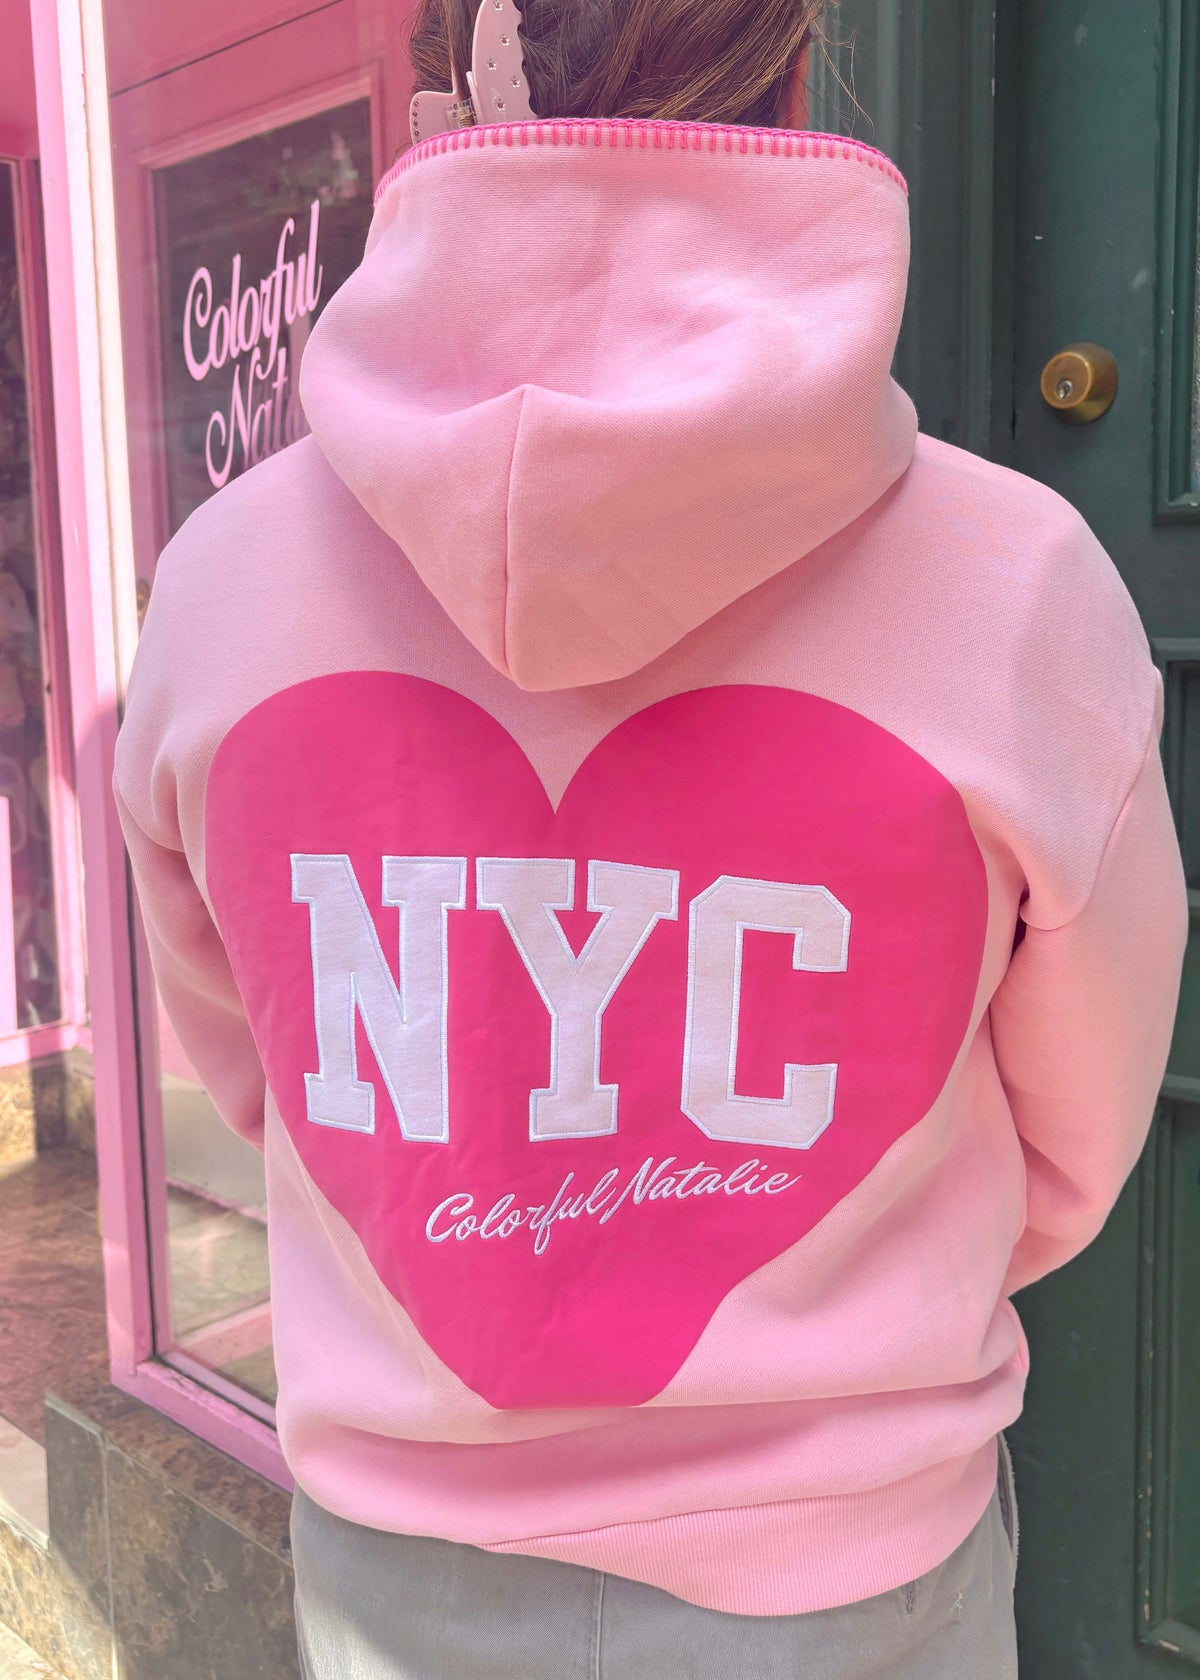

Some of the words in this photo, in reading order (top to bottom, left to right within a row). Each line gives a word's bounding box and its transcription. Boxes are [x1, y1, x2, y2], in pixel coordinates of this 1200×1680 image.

[183, 199, 323, 381] Colorful
[289, 853, 852, 1149] NYC
[425, 1168, 617, 1255] Colorful
[600, 1156, 802, 1225] Natalie
